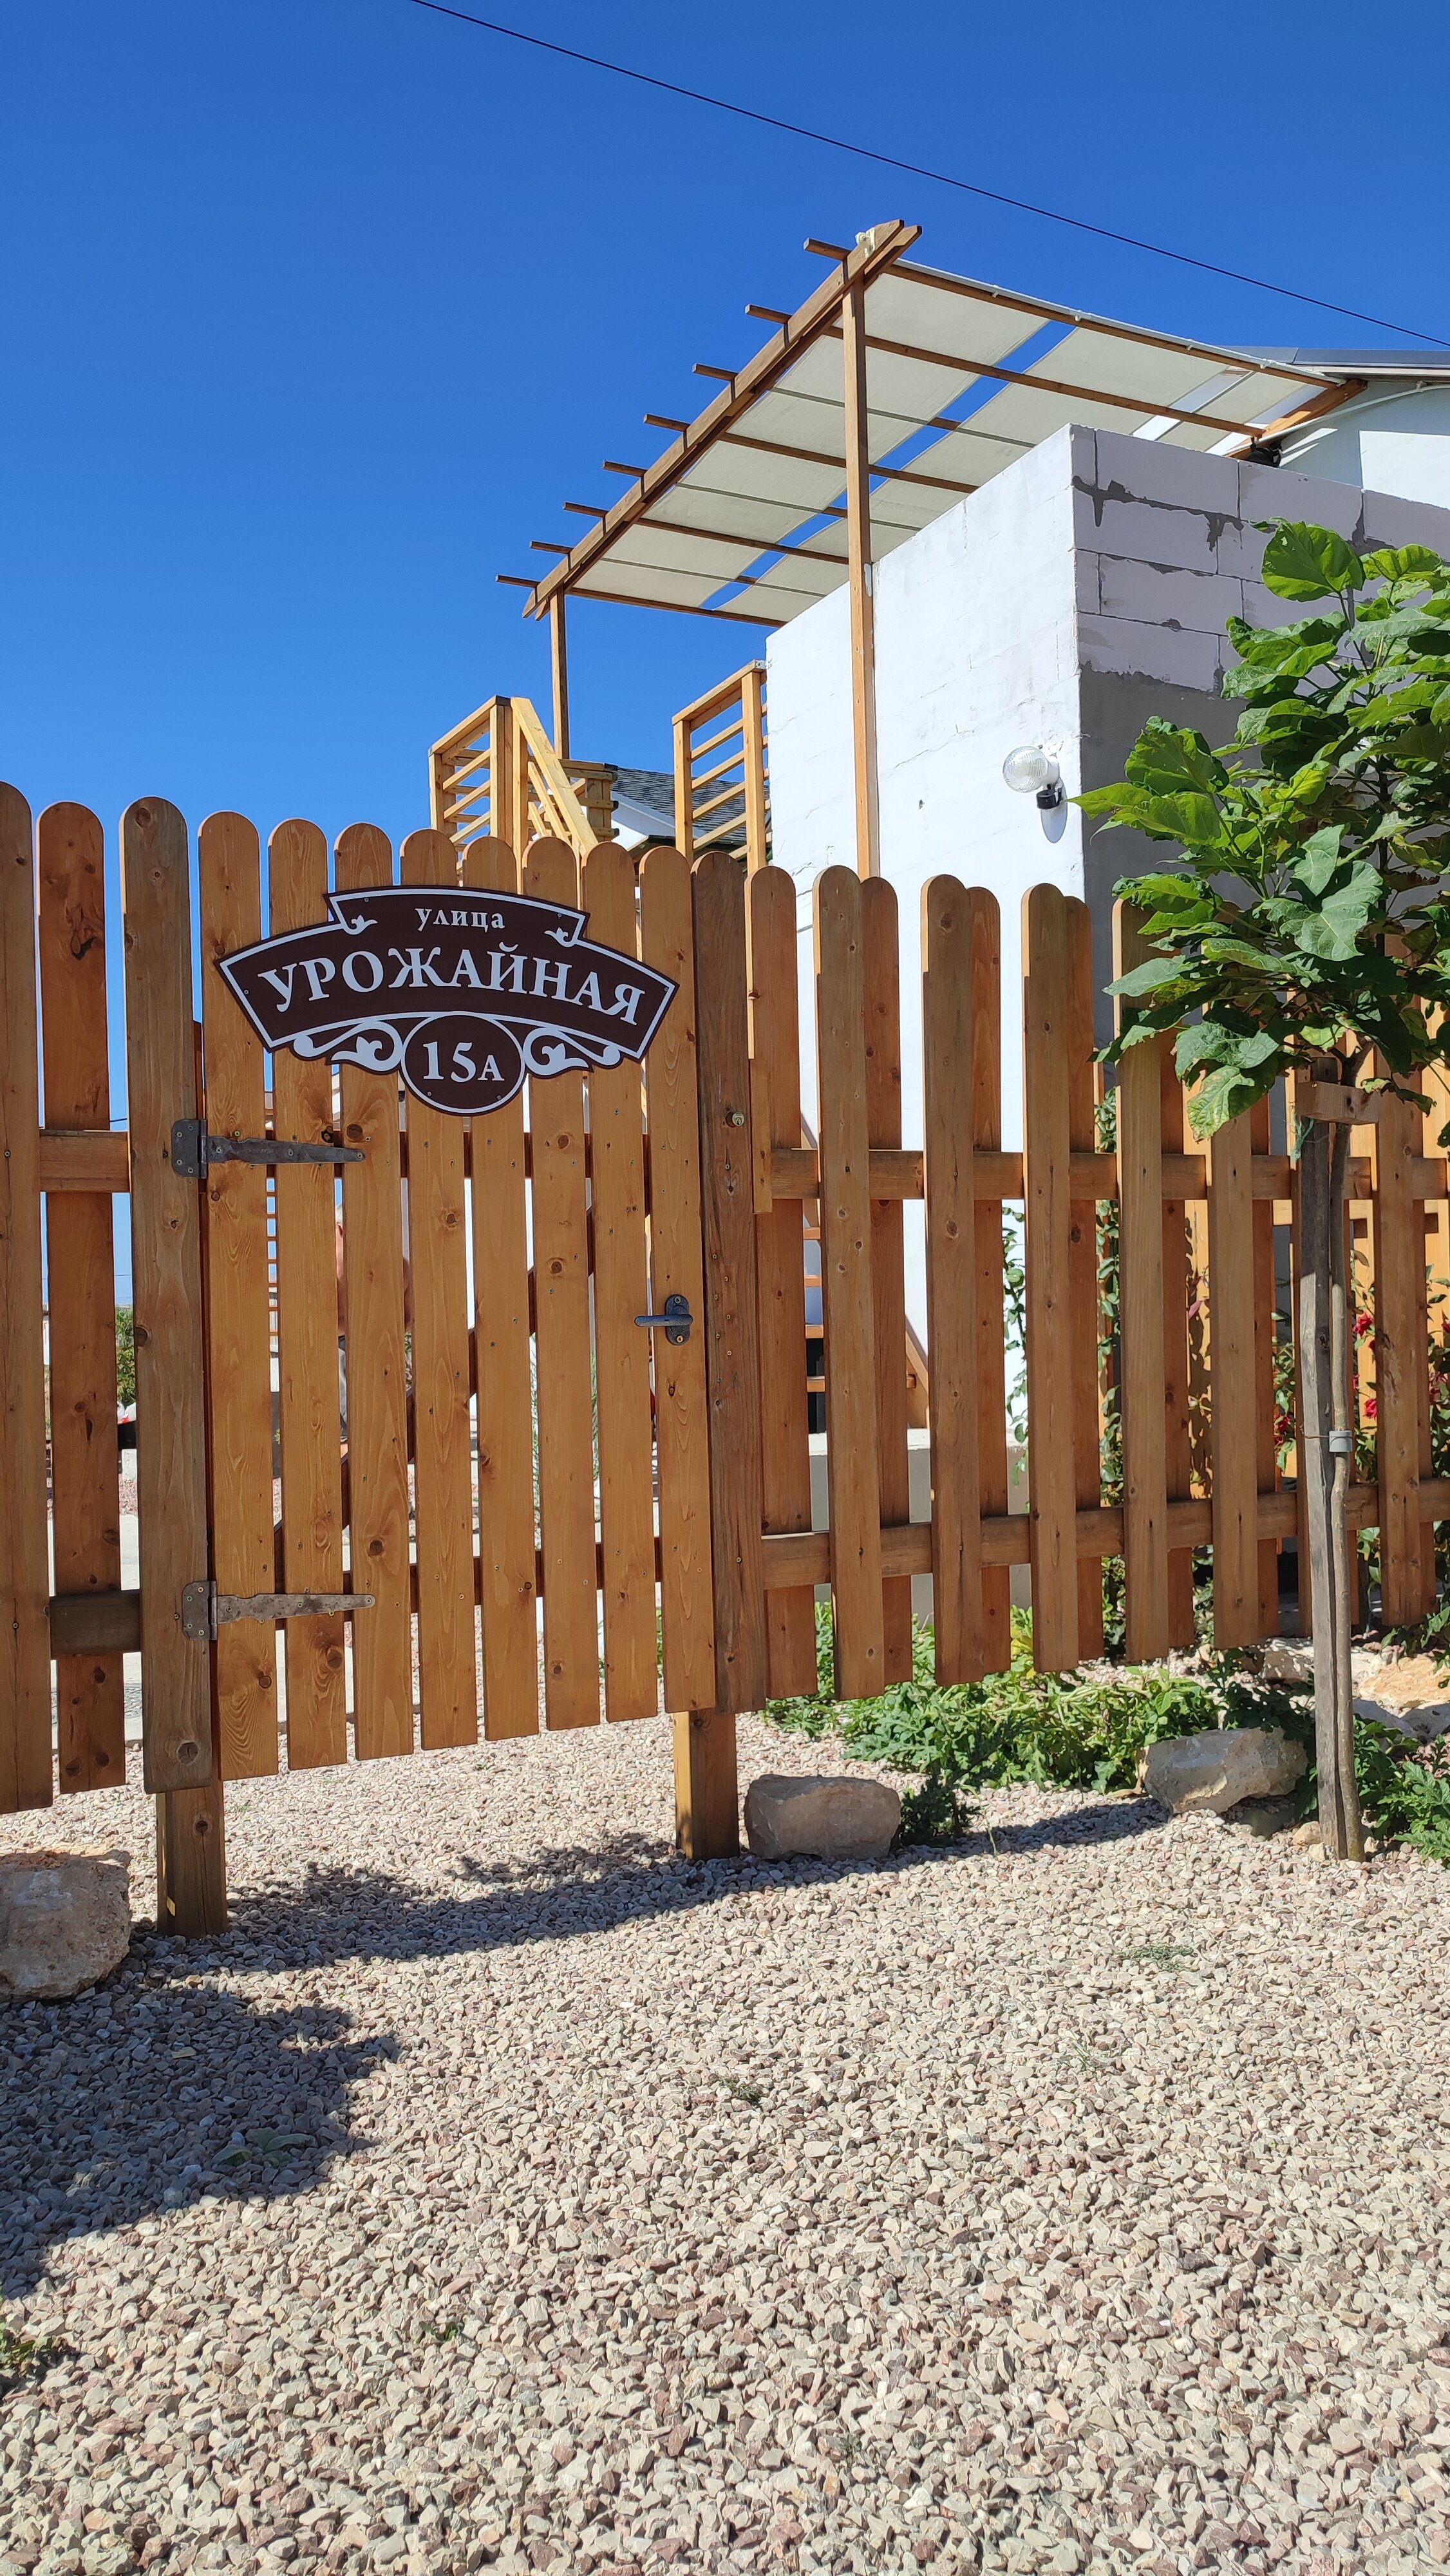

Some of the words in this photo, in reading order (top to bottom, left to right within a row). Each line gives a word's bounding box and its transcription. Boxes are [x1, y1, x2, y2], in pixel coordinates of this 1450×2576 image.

[415, 907, 505, 932] улица
[258, 942, 646, 1025] УРОЖАЙНАЯ
[423, 1041, 504, 1083] 15А
